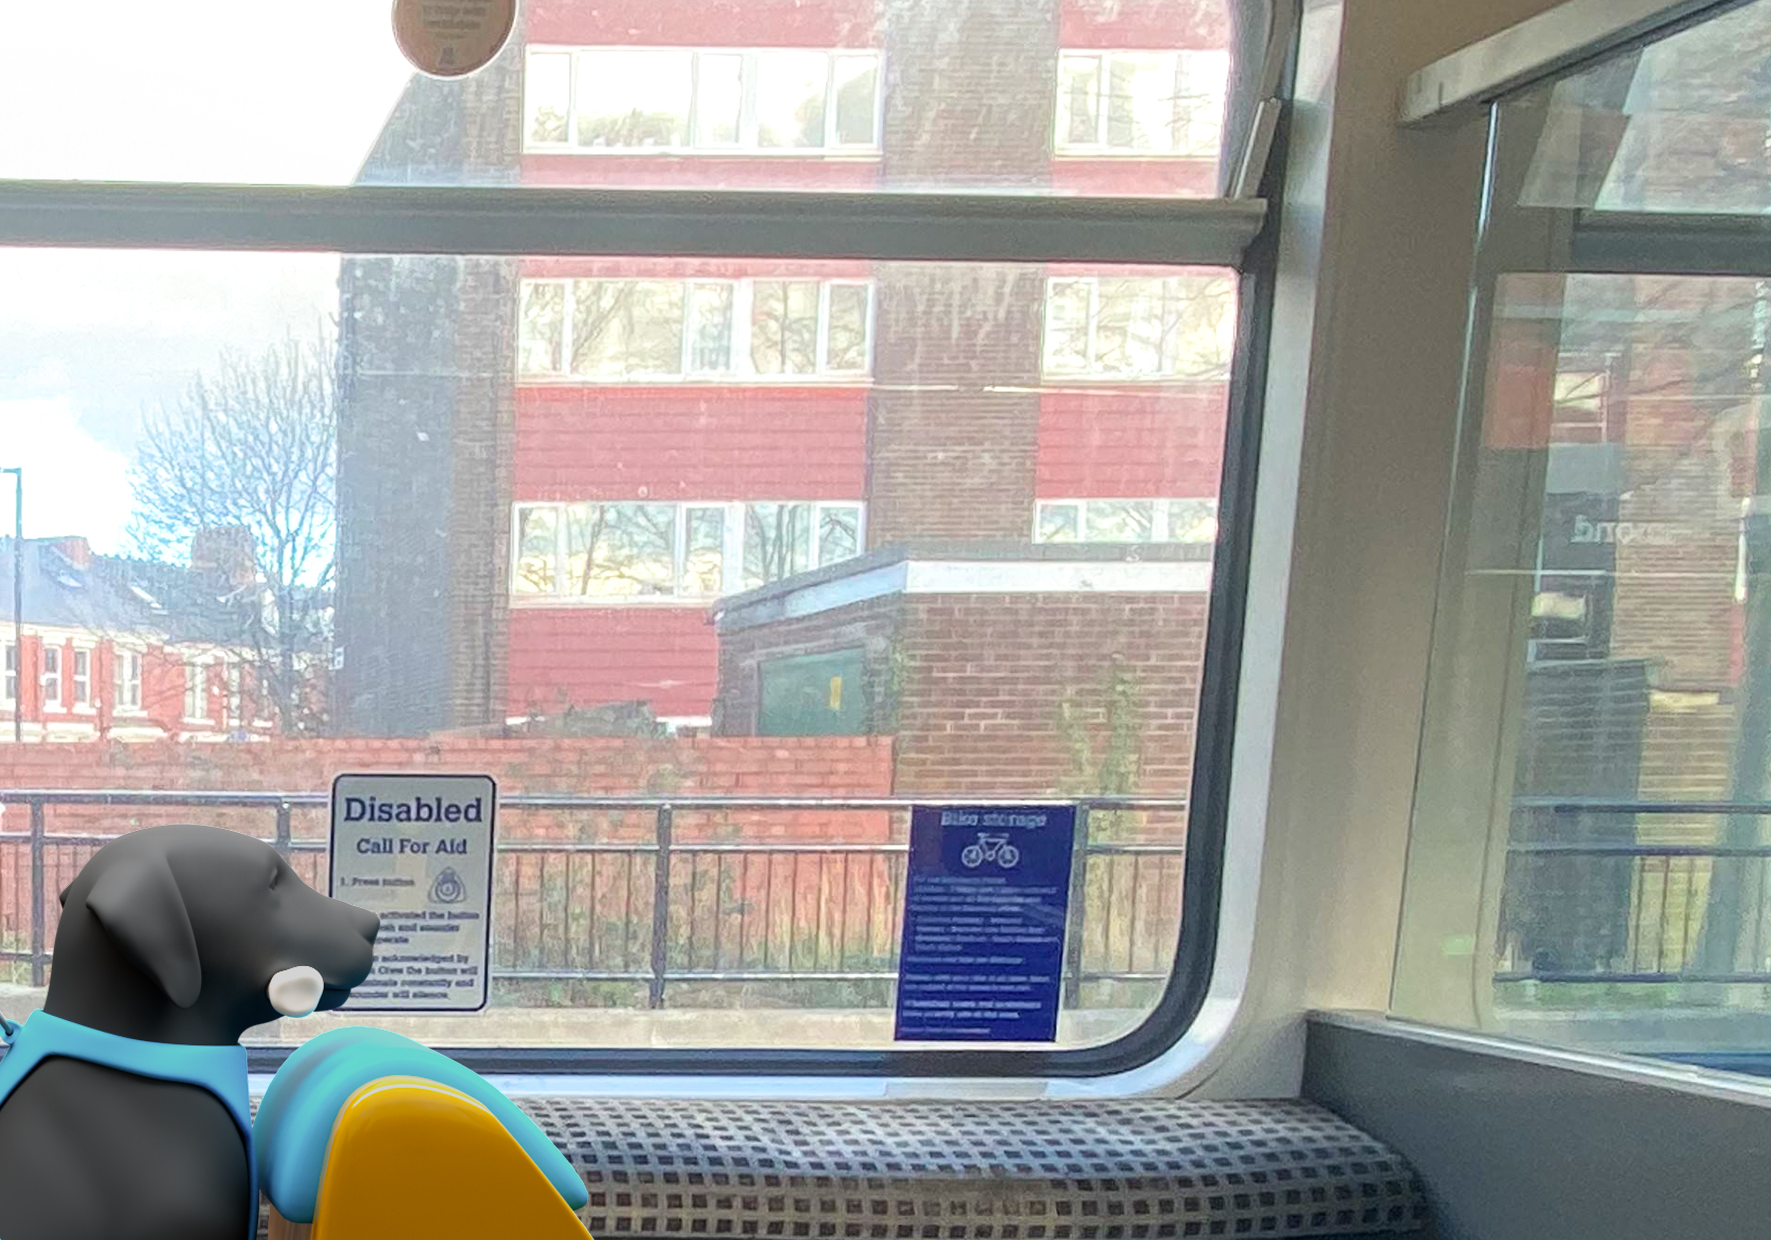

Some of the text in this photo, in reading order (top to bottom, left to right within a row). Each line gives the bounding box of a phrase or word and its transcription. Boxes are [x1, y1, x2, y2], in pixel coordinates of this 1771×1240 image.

[343, 797, 483, 823] Disabled
[356, 838, 468, 855] Call For Aid
[352, 877, 380, 887] Press
[428, 911, 445, 920] the
[447, 911, 480, 920] button
[398, 923, 417, 932] and
[456, 954, 469, 965] by
[406, 966, 423, 975] the
[455, 978, 475, 987] and
